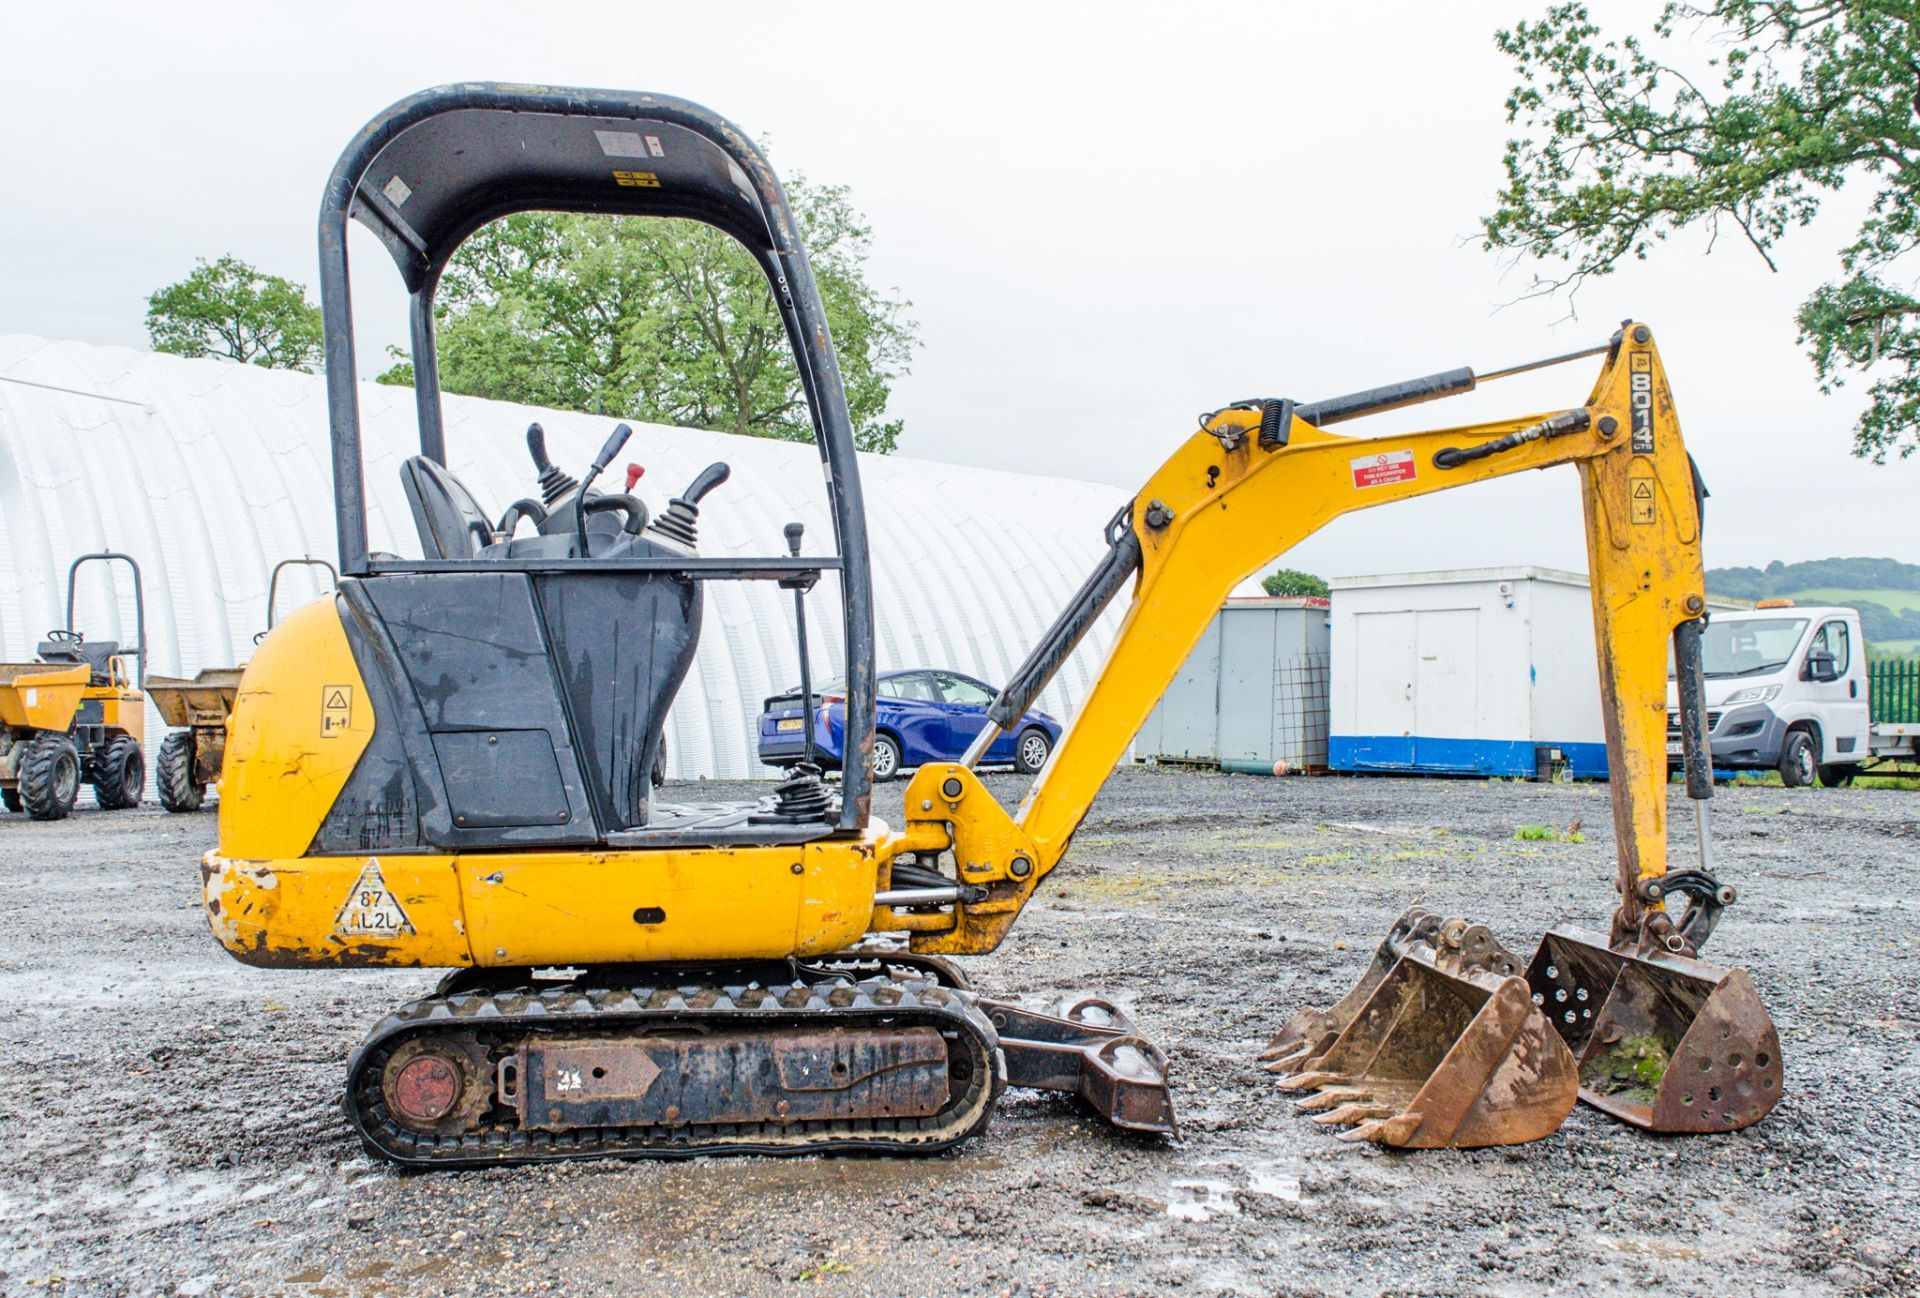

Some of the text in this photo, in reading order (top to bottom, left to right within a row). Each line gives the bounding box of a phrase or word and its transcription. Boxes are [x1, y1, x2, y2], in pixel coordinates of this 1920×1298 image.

[1631, 373, 1653, 443] 8014
[1376, 468, 1407, 478] EXCAVATOR
[360, 891, 383, 908] 87
